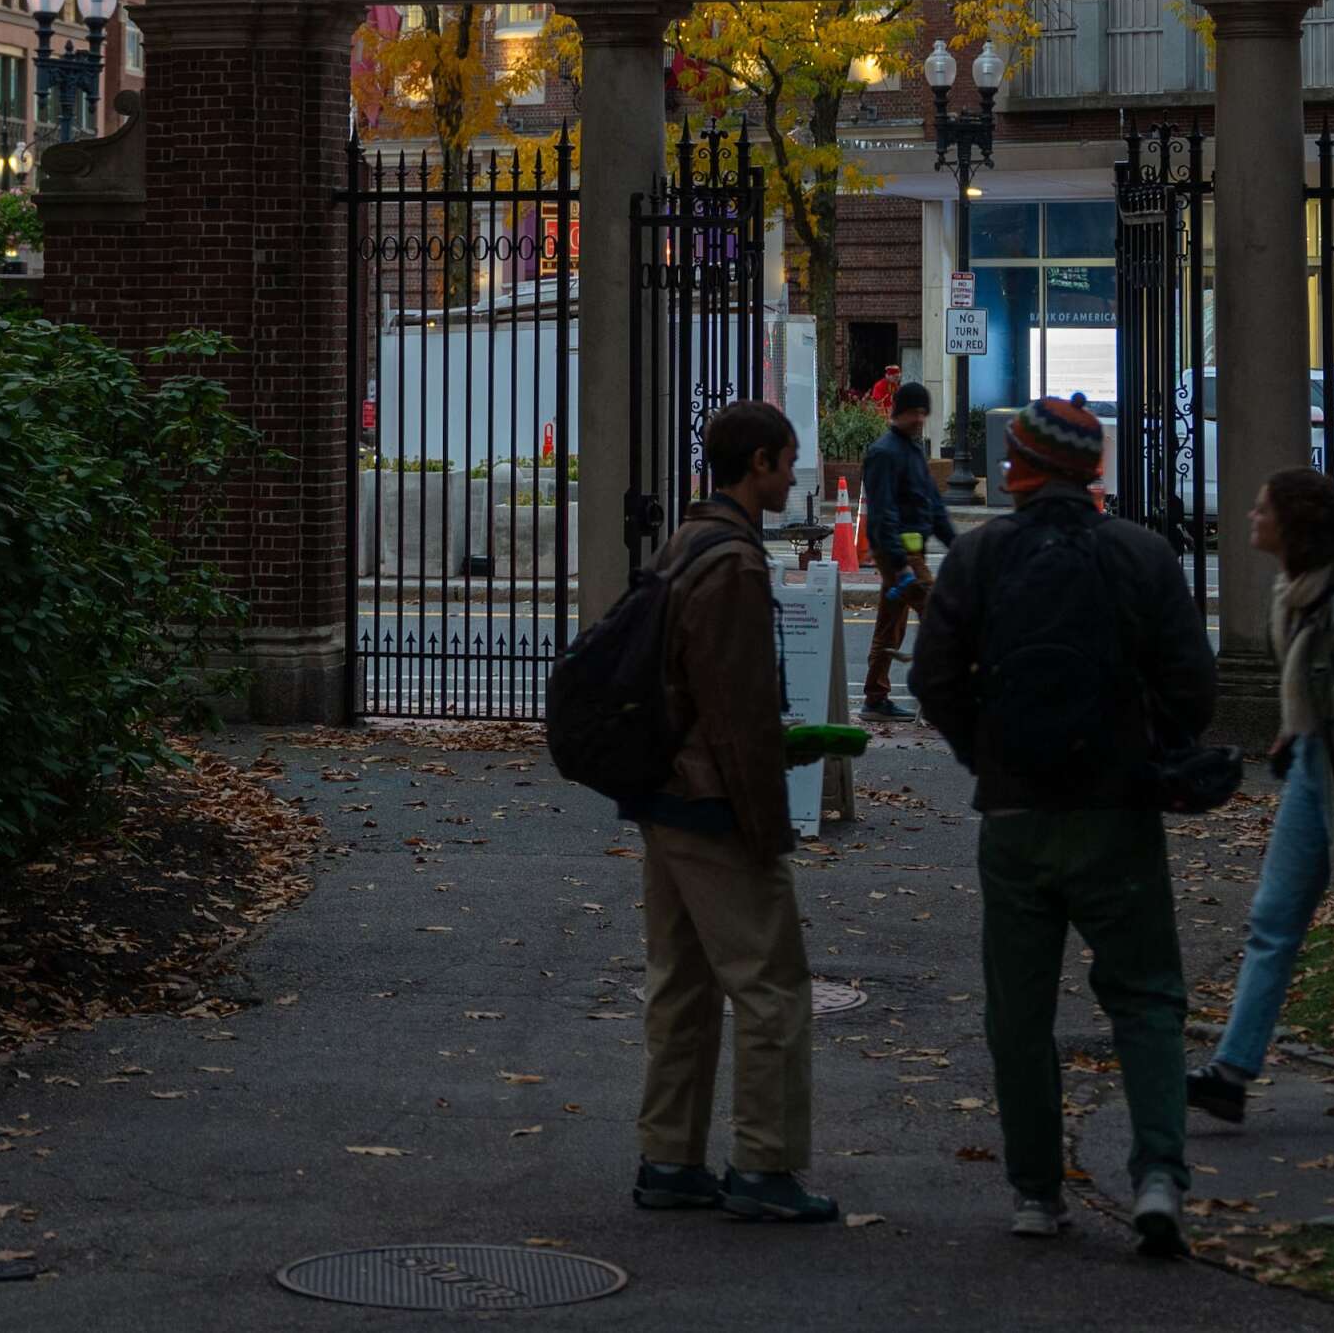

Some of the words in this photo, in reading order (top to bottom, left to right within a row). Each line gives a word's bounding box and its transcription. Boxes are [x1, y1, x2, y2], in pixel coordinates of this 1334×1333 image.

[959, 314, 975, 323] NO
[1058, 313, 1071, 321] OF
[1073, 313, 1116, 322] AMERICA
[955, 327, 979, 336] TURN
[950, 339, 962, 349] ON
[966, 339, 983, 349] RED
